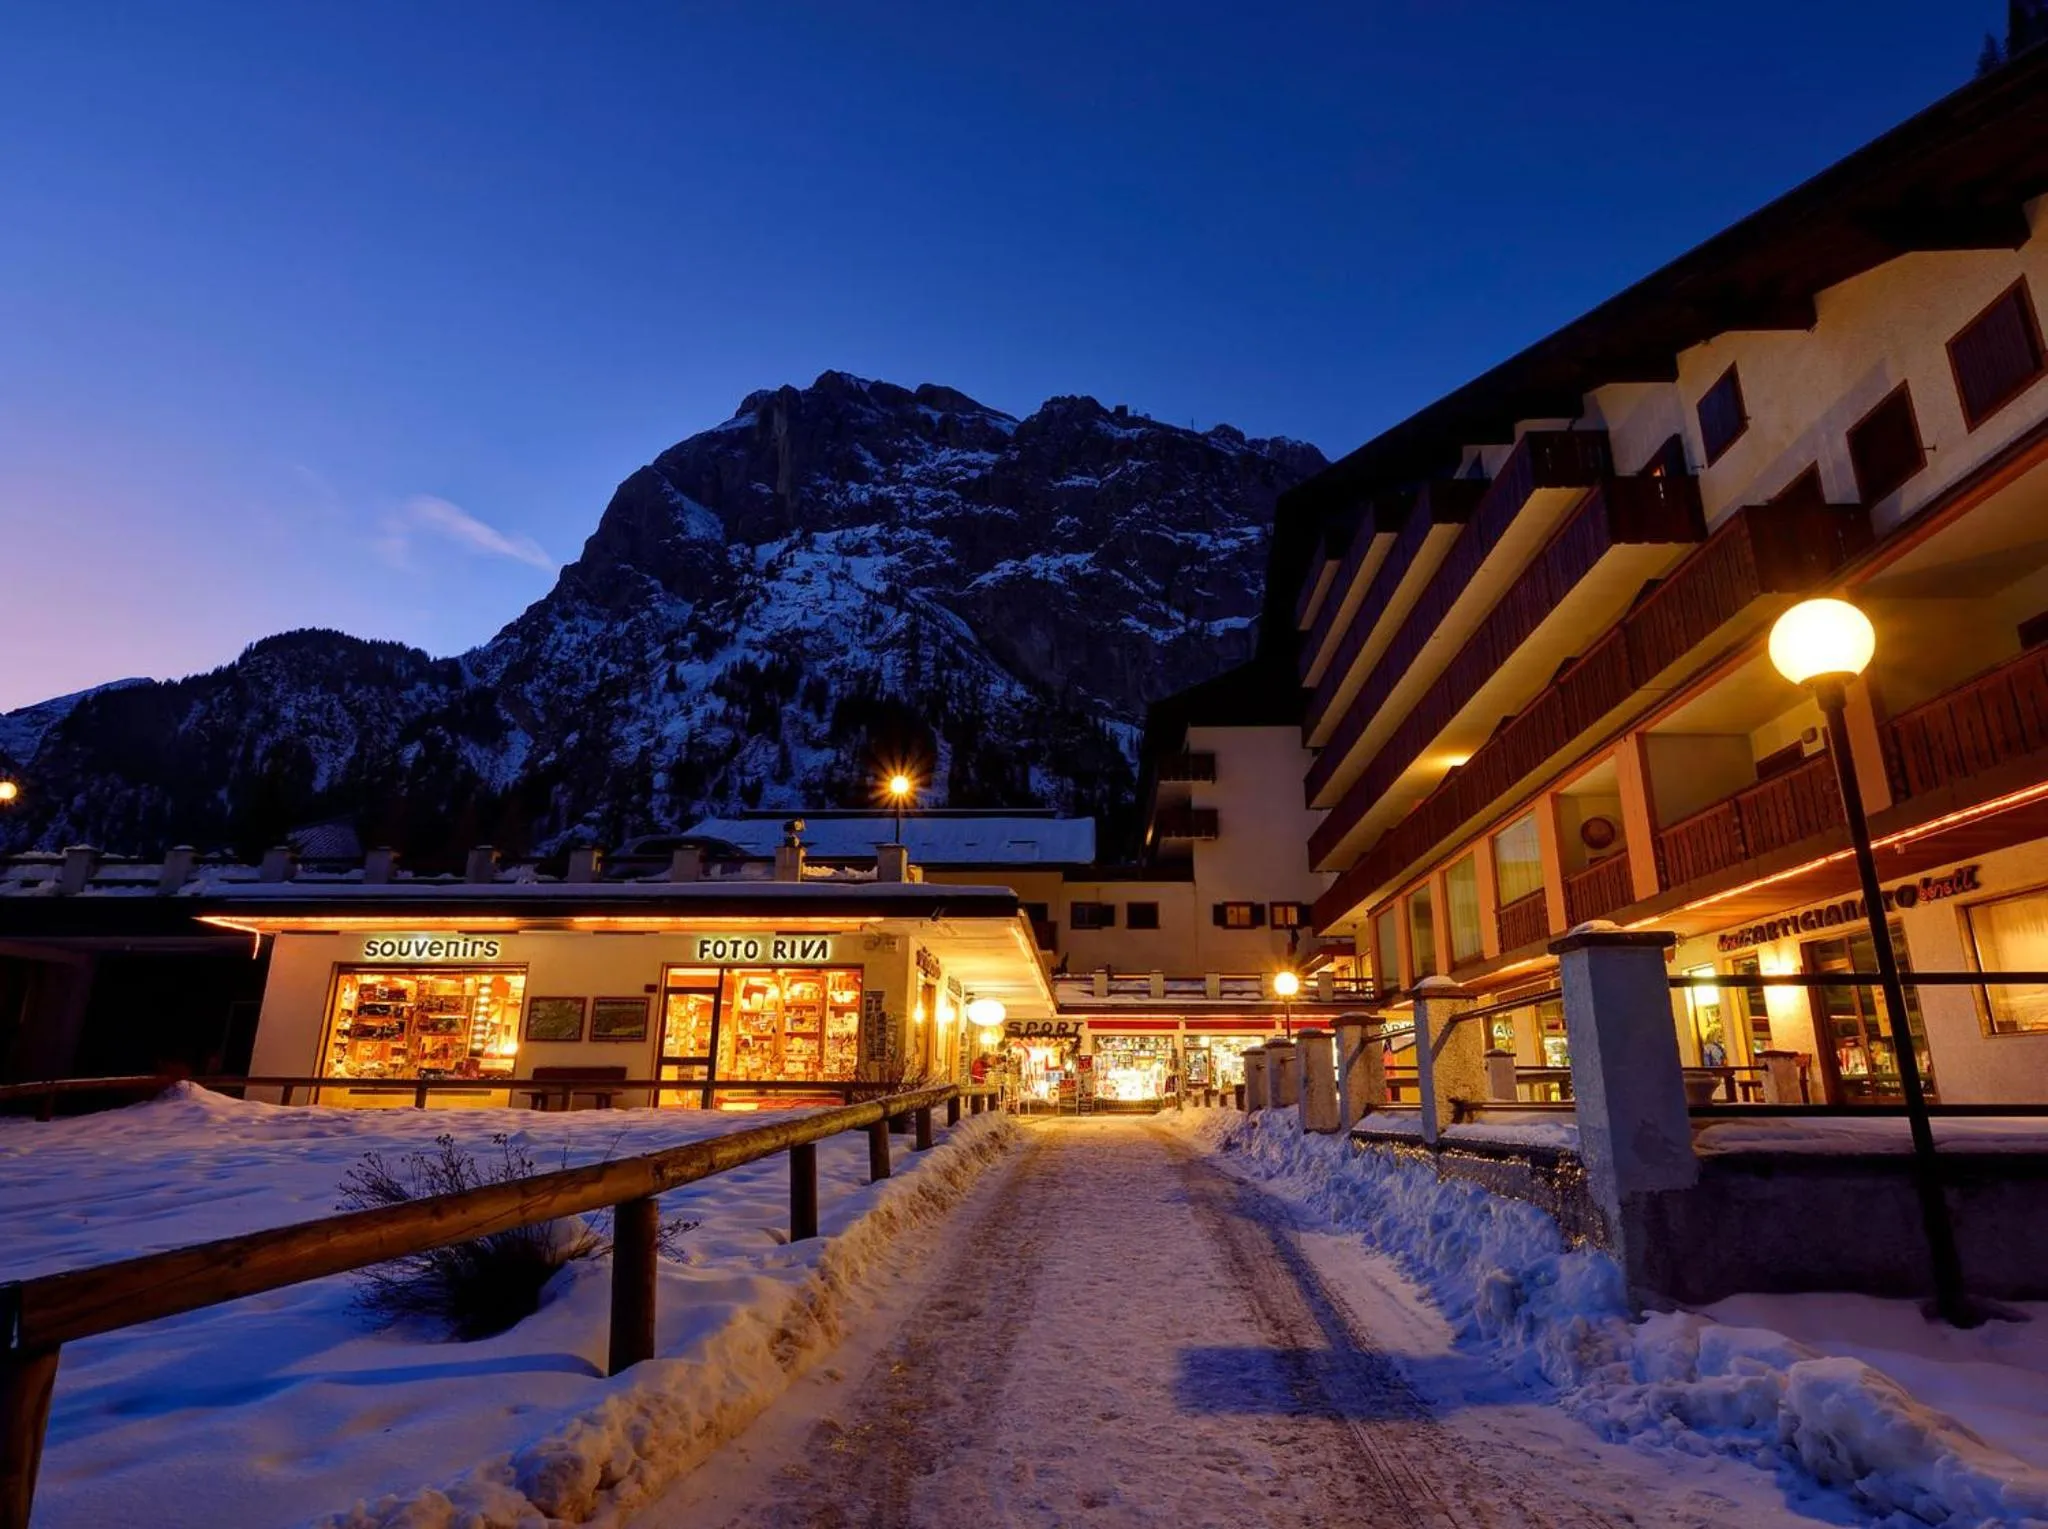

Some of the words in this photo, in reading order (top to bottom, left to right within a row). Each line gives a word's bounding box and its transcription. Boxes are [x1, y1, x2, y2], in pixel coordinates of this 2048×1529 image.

[1752, 885, 1917, 945] ARTIGIANTO
[364, 937, 499, 957] souvenirs
[699, 940, 758, 959] FOTO
[773, 940, 828, 959] RIVA
[1007, 1021, 1084, 1037] SPORT
